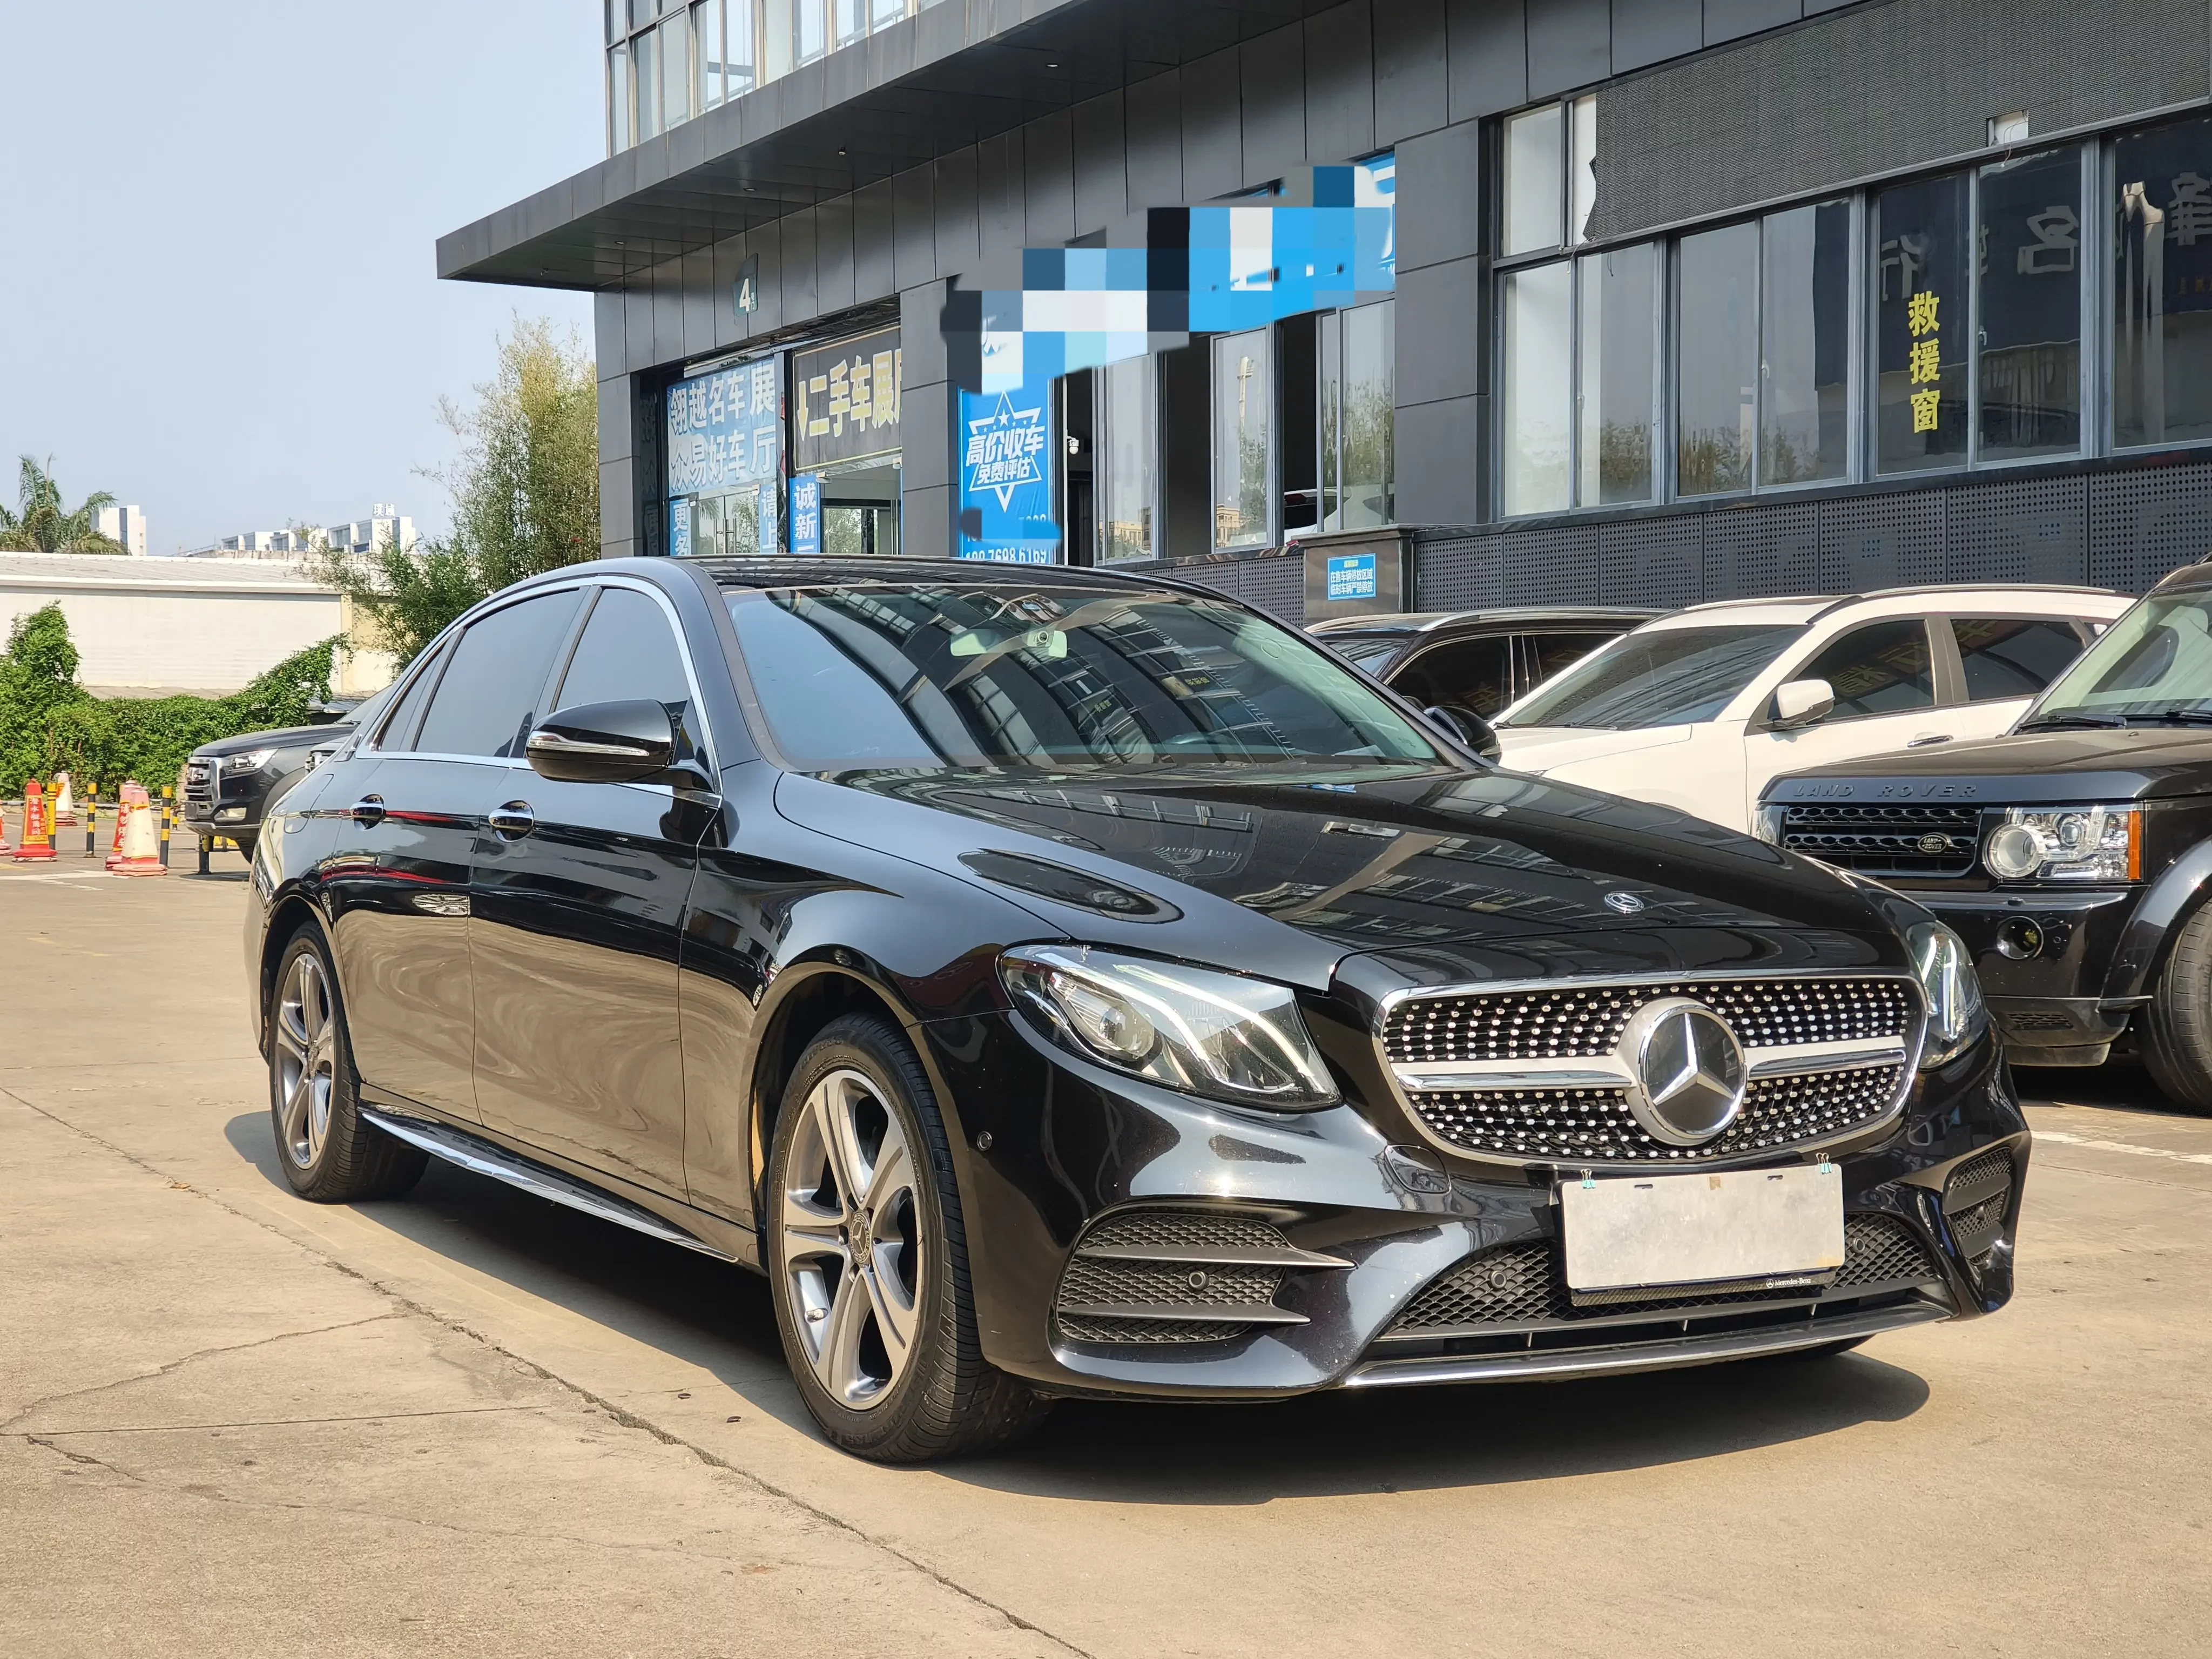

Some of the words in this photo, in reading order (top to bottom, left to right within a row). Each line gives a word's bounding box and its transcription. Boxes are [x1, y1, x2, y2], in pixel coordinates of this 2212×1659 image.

[1908, 291, 1940, 433] 救援窗
[809, 348, 902, 437] 二手车展
[966, 424, 1046, 467] 高价收车
[977, 456, 1032, 484] 免费评估
[1793, 784, 1856, 797] LAND
[1877, 784, 1977, 797] ROVER
[1775, 1278, 1811, 1286] Mercedes-Benz
